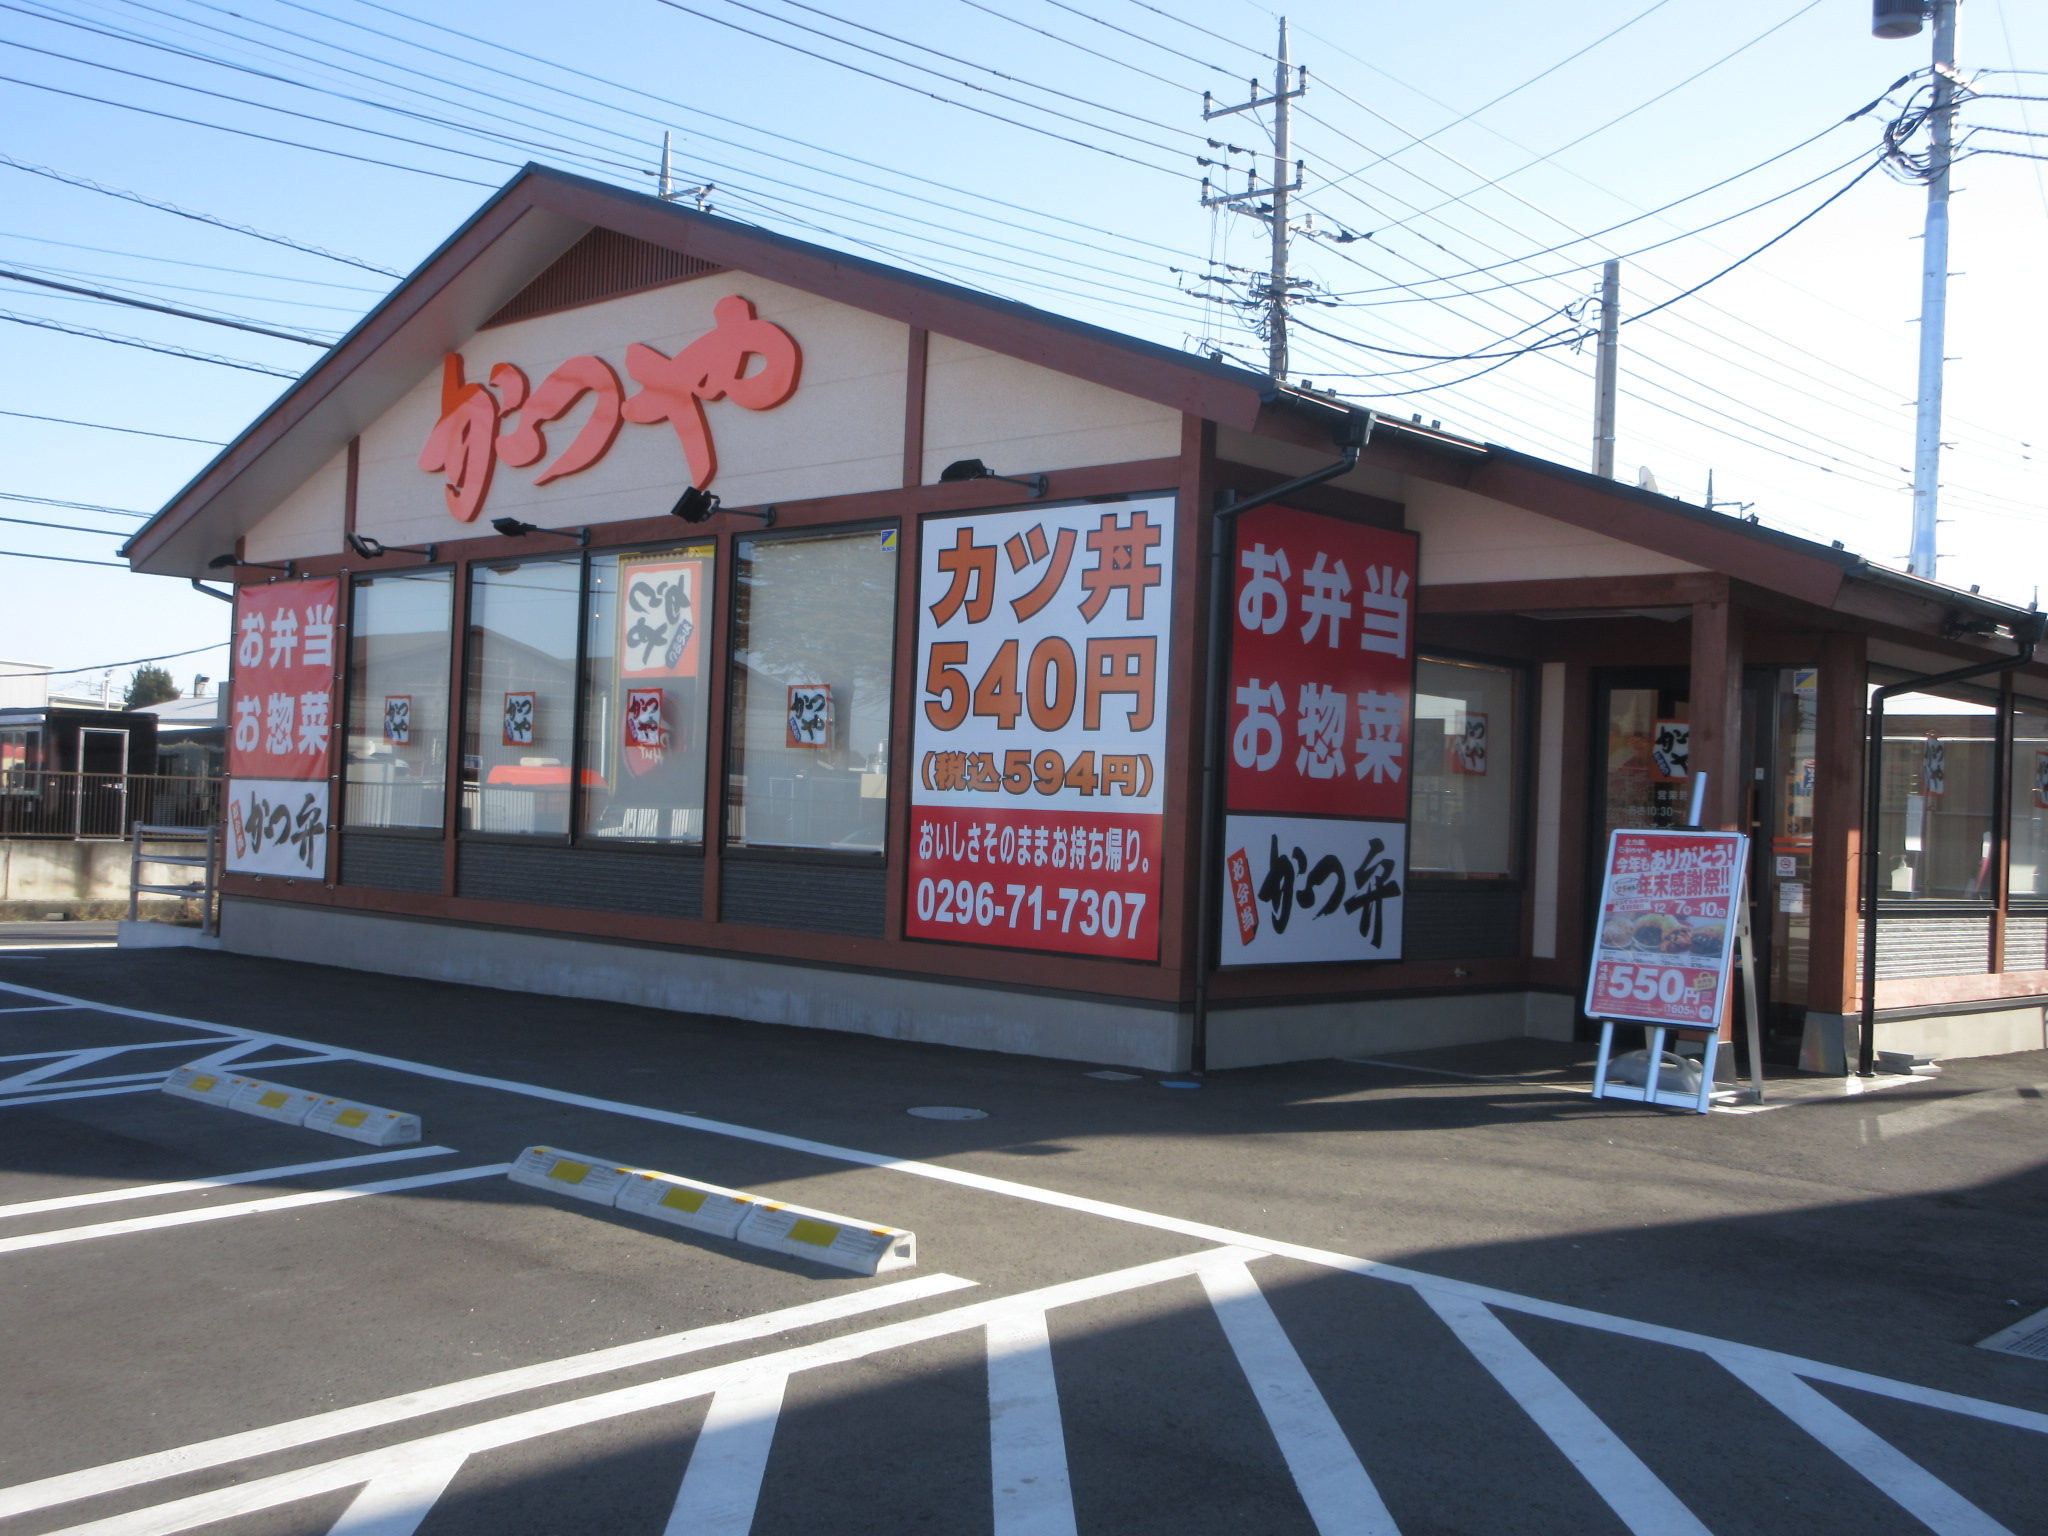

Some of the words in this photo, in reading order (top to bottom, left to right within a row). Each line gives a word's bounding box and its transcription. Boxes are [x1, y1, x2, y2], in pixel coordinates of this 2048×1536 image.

[417, 294, 801, 523] かつや
[929, 511, 1161, 629] カツ丼
[1239, 542, 1410, 659] お弁当
[239, 604, 334, 668] お弁当
[790, 692, 825, 740] かつや
[924, 636, 1157, 732] 540円
[235, 691, 330, 755] お惣菜
[386, 701, 408, 739] かつや
[505, 698, 532, 739] かつや
[628, 696, 659, 739] かつや
[1233, 678, 1402, 783] お惣菜
[921, 748, 1154, 797] (税込594円)
[245, 791, 325, 869] かつ弁
[919, 820, 1149, 873] おいしさそのままお持ち帰り。
[917, 877, 1147, 939] 0296-71-7307
[1258, 834, 1402, 949] かつ弁
[1608, 965, 1701, 1005] 550円
